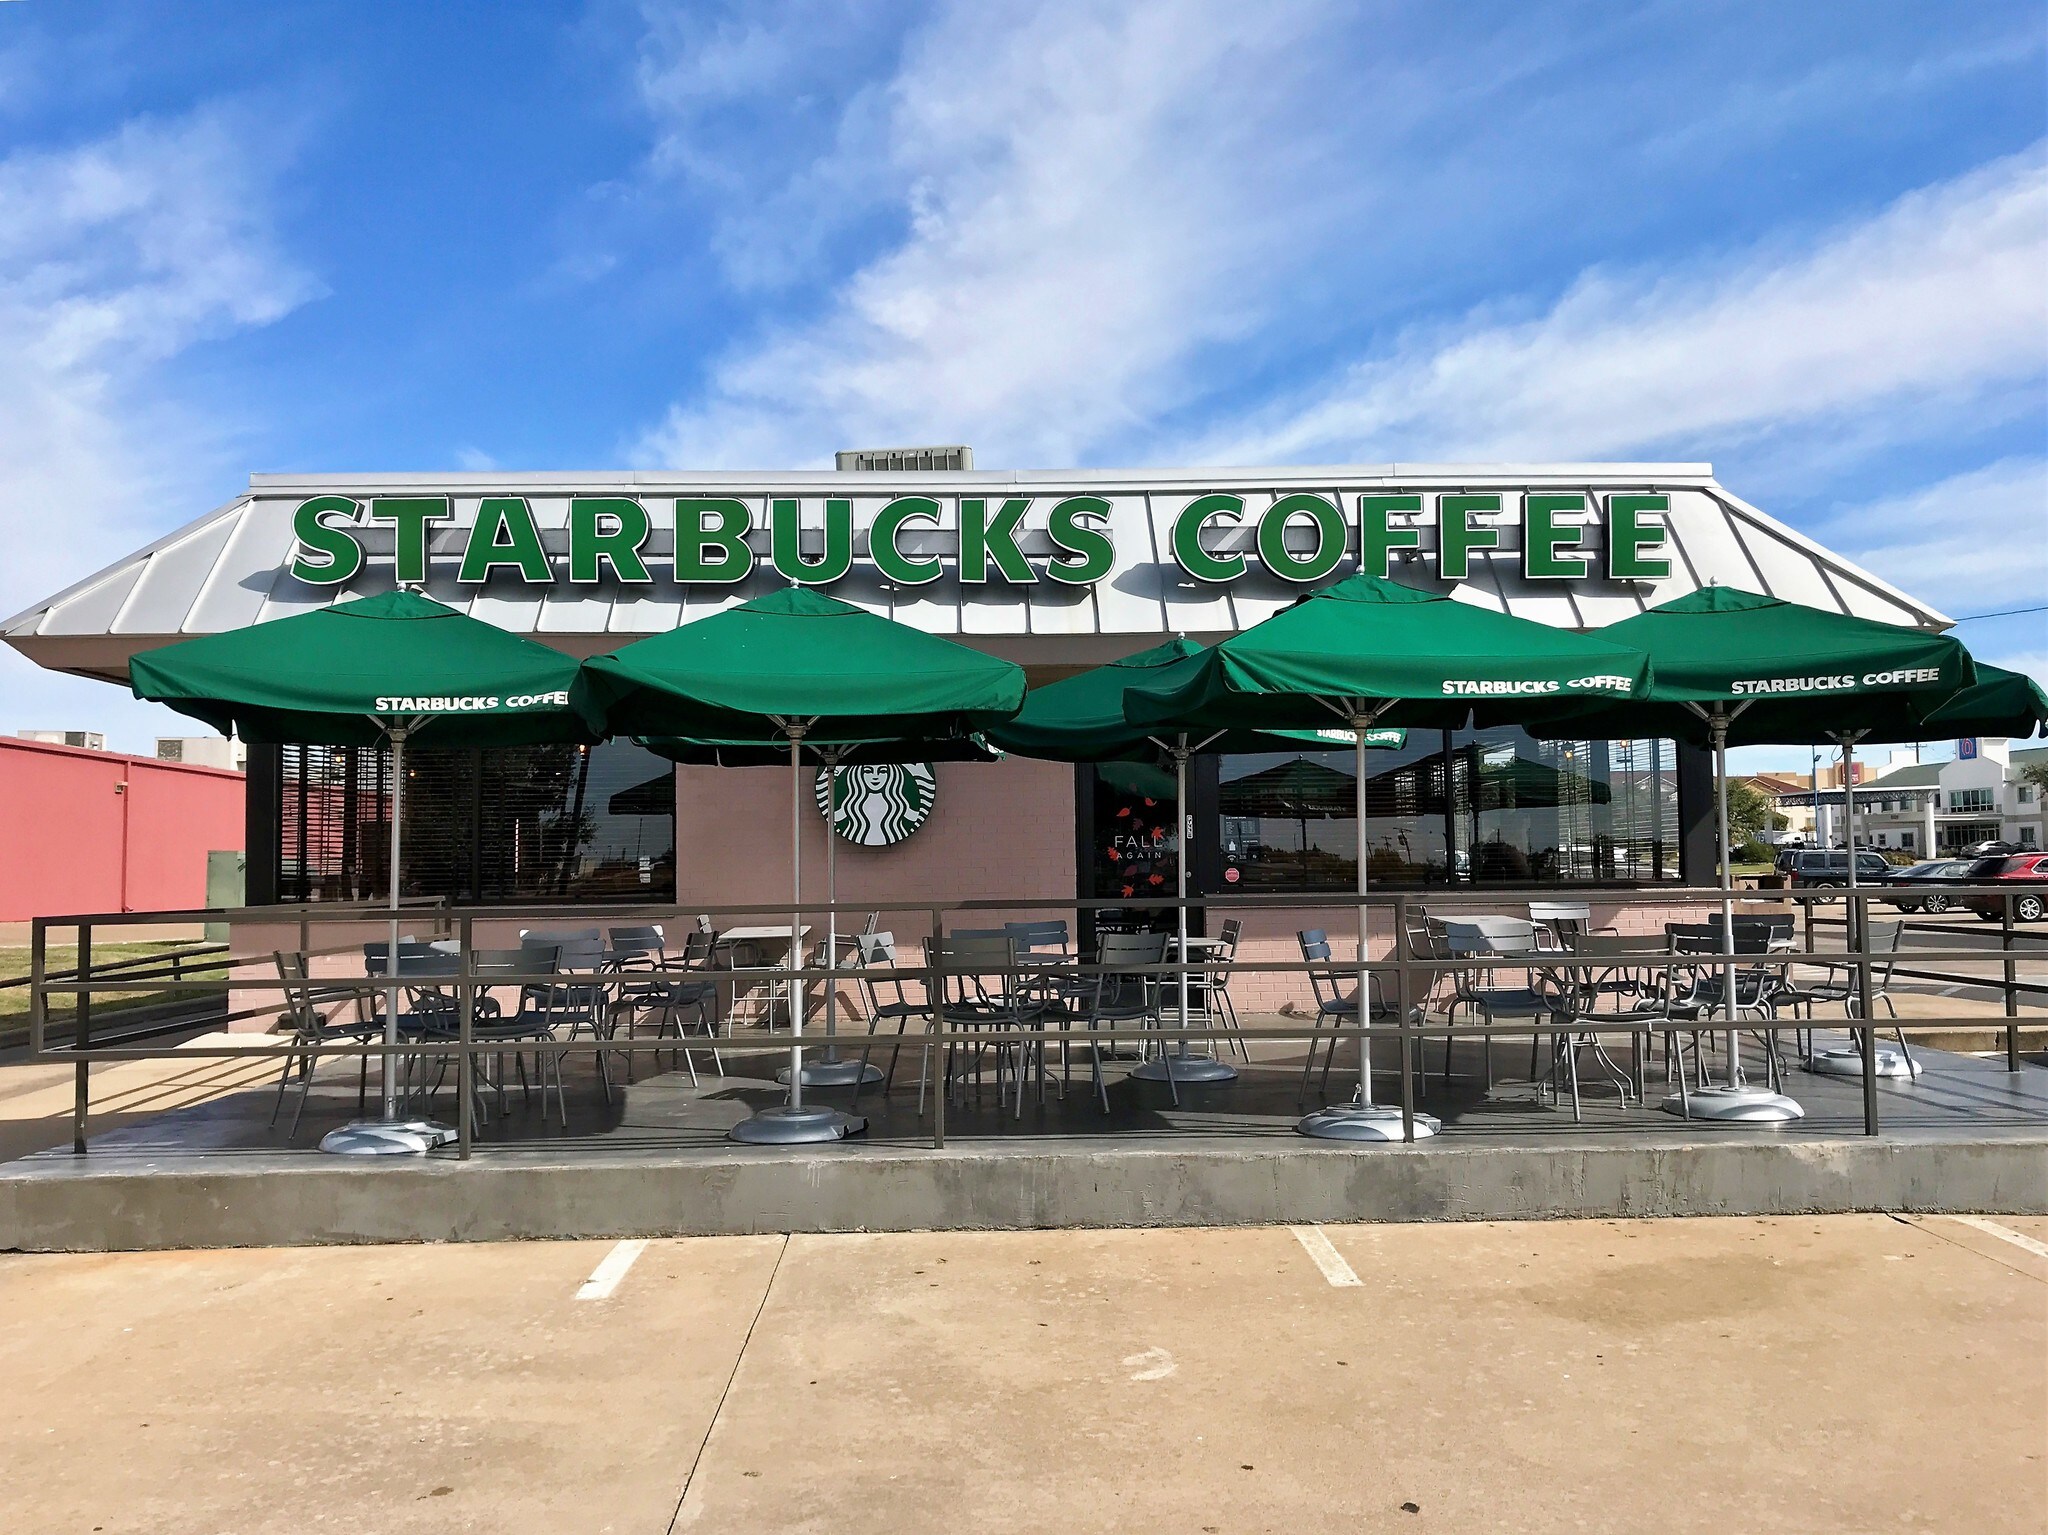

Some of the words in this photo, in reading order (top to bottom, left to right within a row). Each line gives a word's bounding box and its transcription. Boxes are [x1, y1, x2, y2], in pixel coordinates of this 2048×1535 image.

[290, 494, 1116, 585] STARBUCKS
[1173, 492, 1671, 582] COFFEE
[1442, 679, 1560, 694] STARBUCKS
[1566, 675, 1633, 692] COFFEE
[1731, 674, 1856, 695] STARBUCKS
[1863, 667, 1940, 686] COFFEE
[375, 696, 499, 712] STARBUCKS
[1961, 738, 1974, 756] 6
[1114, 835, 1163, 848] FALL
[1116, 851, 1162, 860] AGAIN
